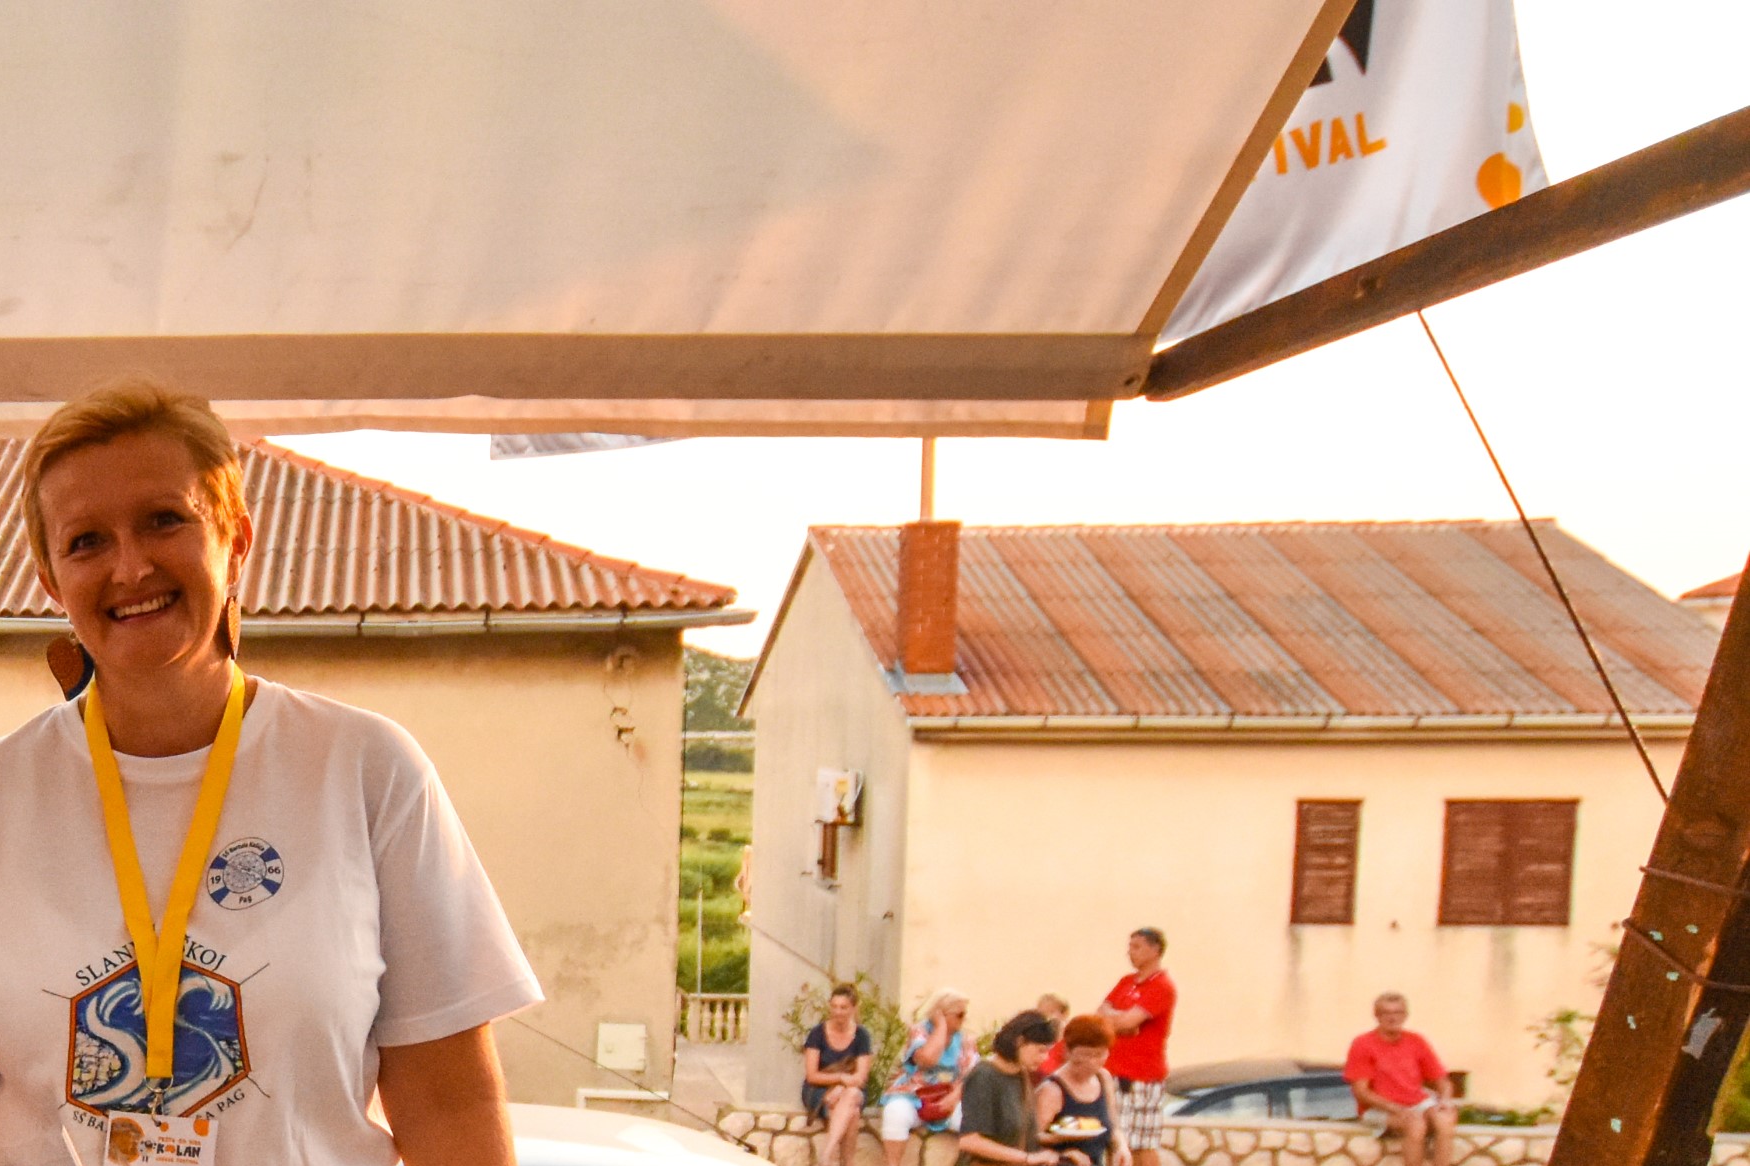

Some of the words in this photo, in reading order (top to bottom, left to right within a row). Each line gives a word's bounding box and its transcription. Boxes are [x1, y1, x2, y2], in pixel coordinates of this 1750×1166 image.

[1273, 112, 1387, 175] IVAL
[210, 875, 221, 885] 19
[267, 865, 281, 875] 66
[75, 941, 135, 987] SLAN
[216, 1087, 246, 1114] PAG
